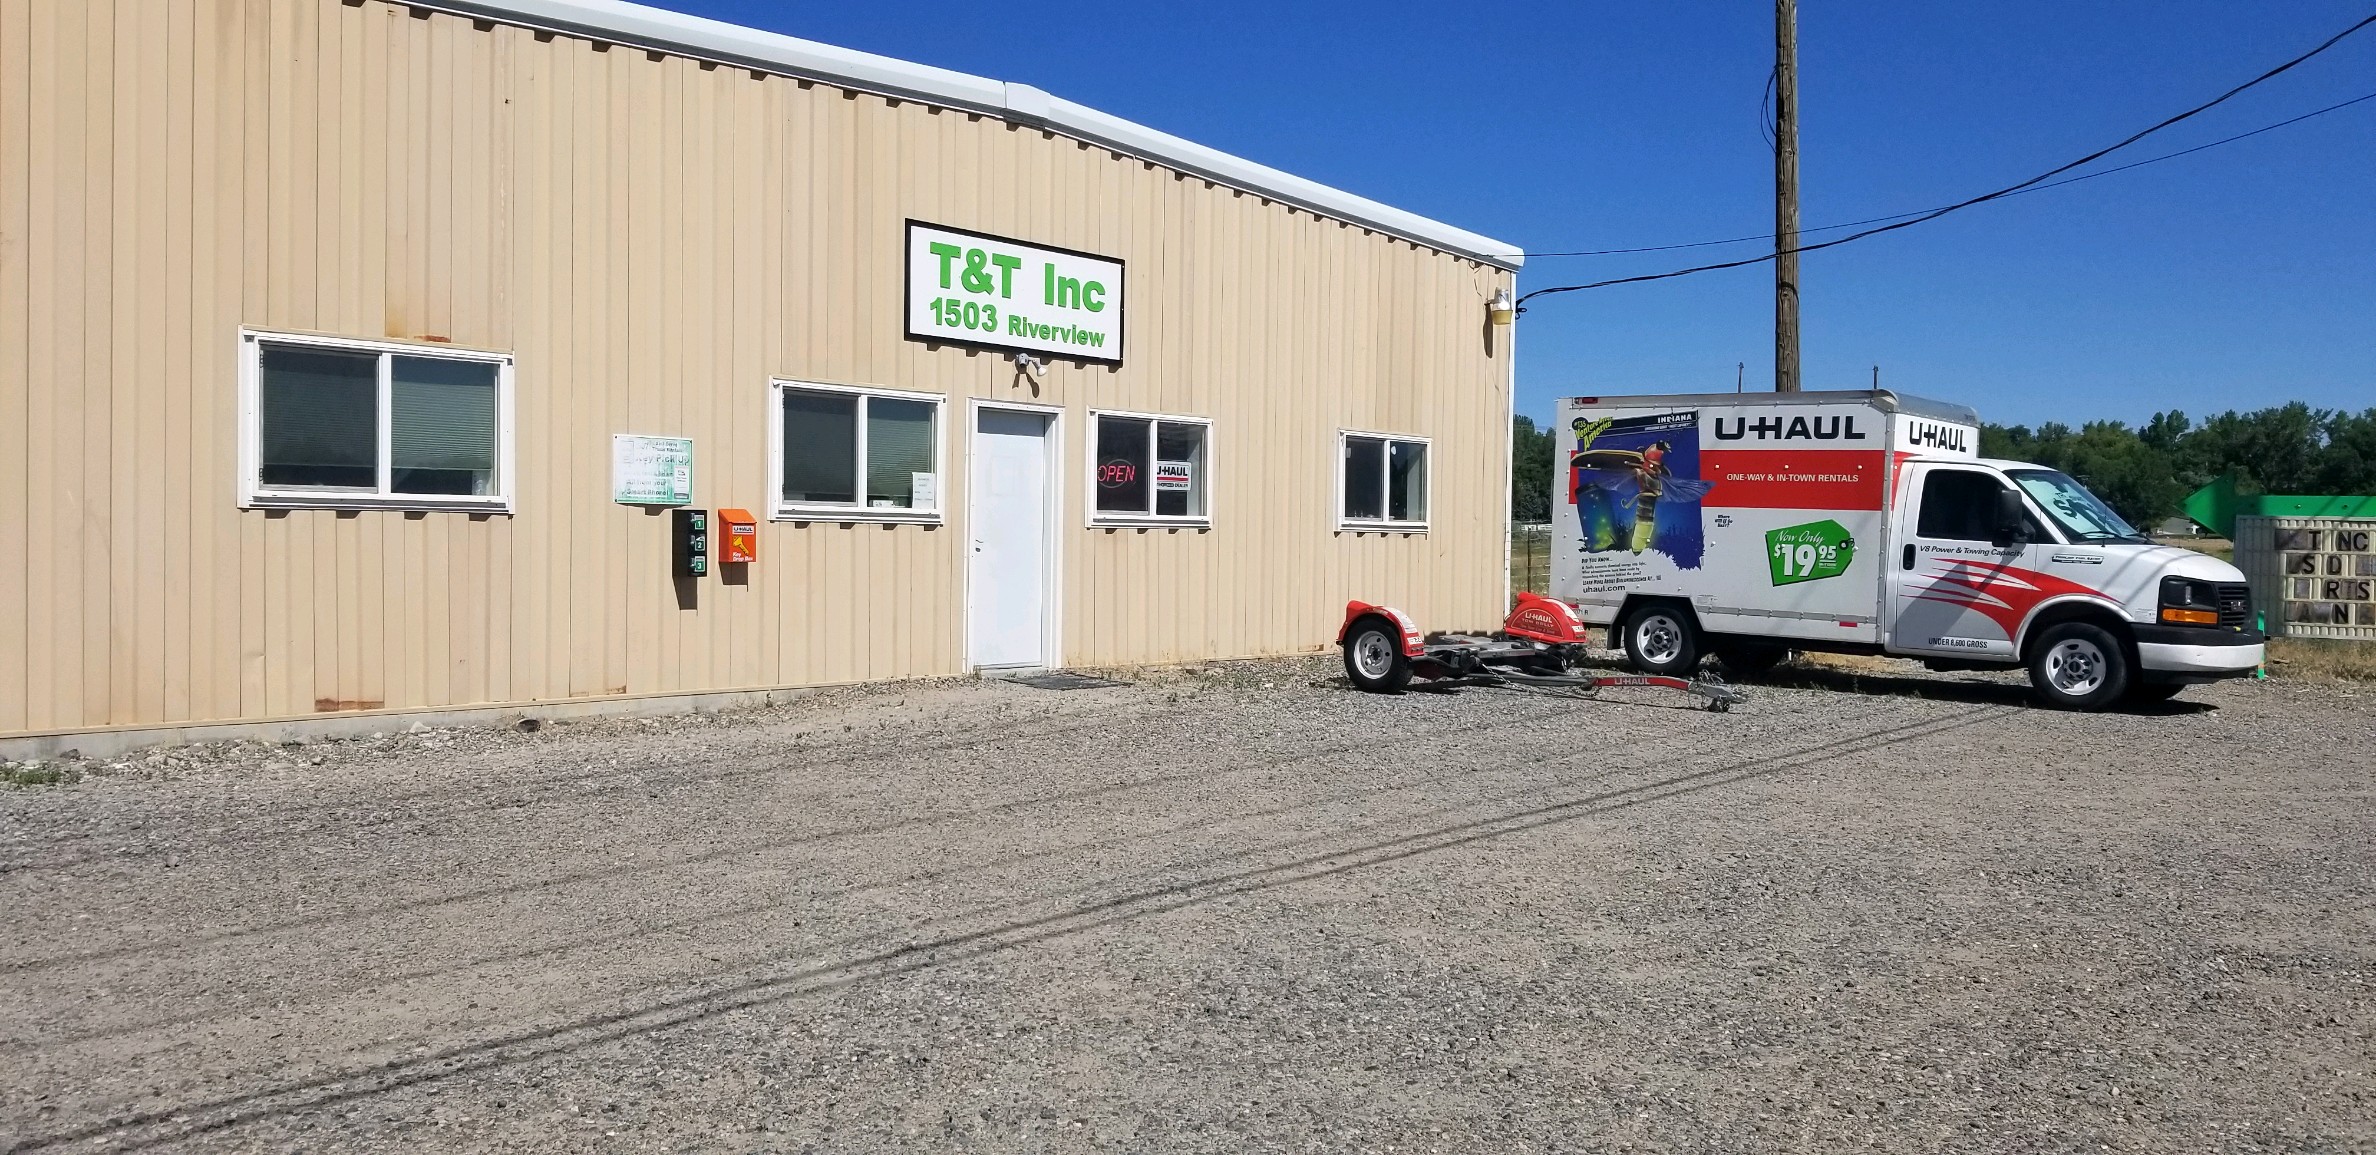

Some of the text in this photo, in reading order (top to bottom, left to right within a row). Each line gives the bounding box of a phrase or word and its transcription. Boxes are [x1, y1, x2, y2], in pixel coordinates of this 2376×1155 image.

[930, 241, 1106, 312] T&T Inc
[930, 297, 1105, 347] 1503 Riverview
[1657, 413, 1692, 423] INDIANA
[1714, 415, 1866, 440] U-HAUL
[1909, 420, 1966, 453] U-HAUL
[1097, 465, 1135, 481] OPEN
[1726, 473, 1765, 481] ONE-WAY
[1818, 474, 1859, 482] RENTALS
[1775, 530, 1825, 547] Now Only
[1931, 546, 1955, 554] Power
[1964, 547, 1989, 556] Towing
[1991, 548, 2025, 558] Capacity
[1582, 585, 1626, 593] uhaul.com
[1525, 612, 1553, 623] U-HAUL
[1928, 637, 1949, 645] UNDER
[1966, 639, 1988, 648] GROSS
[1615, 677, 1650, 685] U-HAUL
